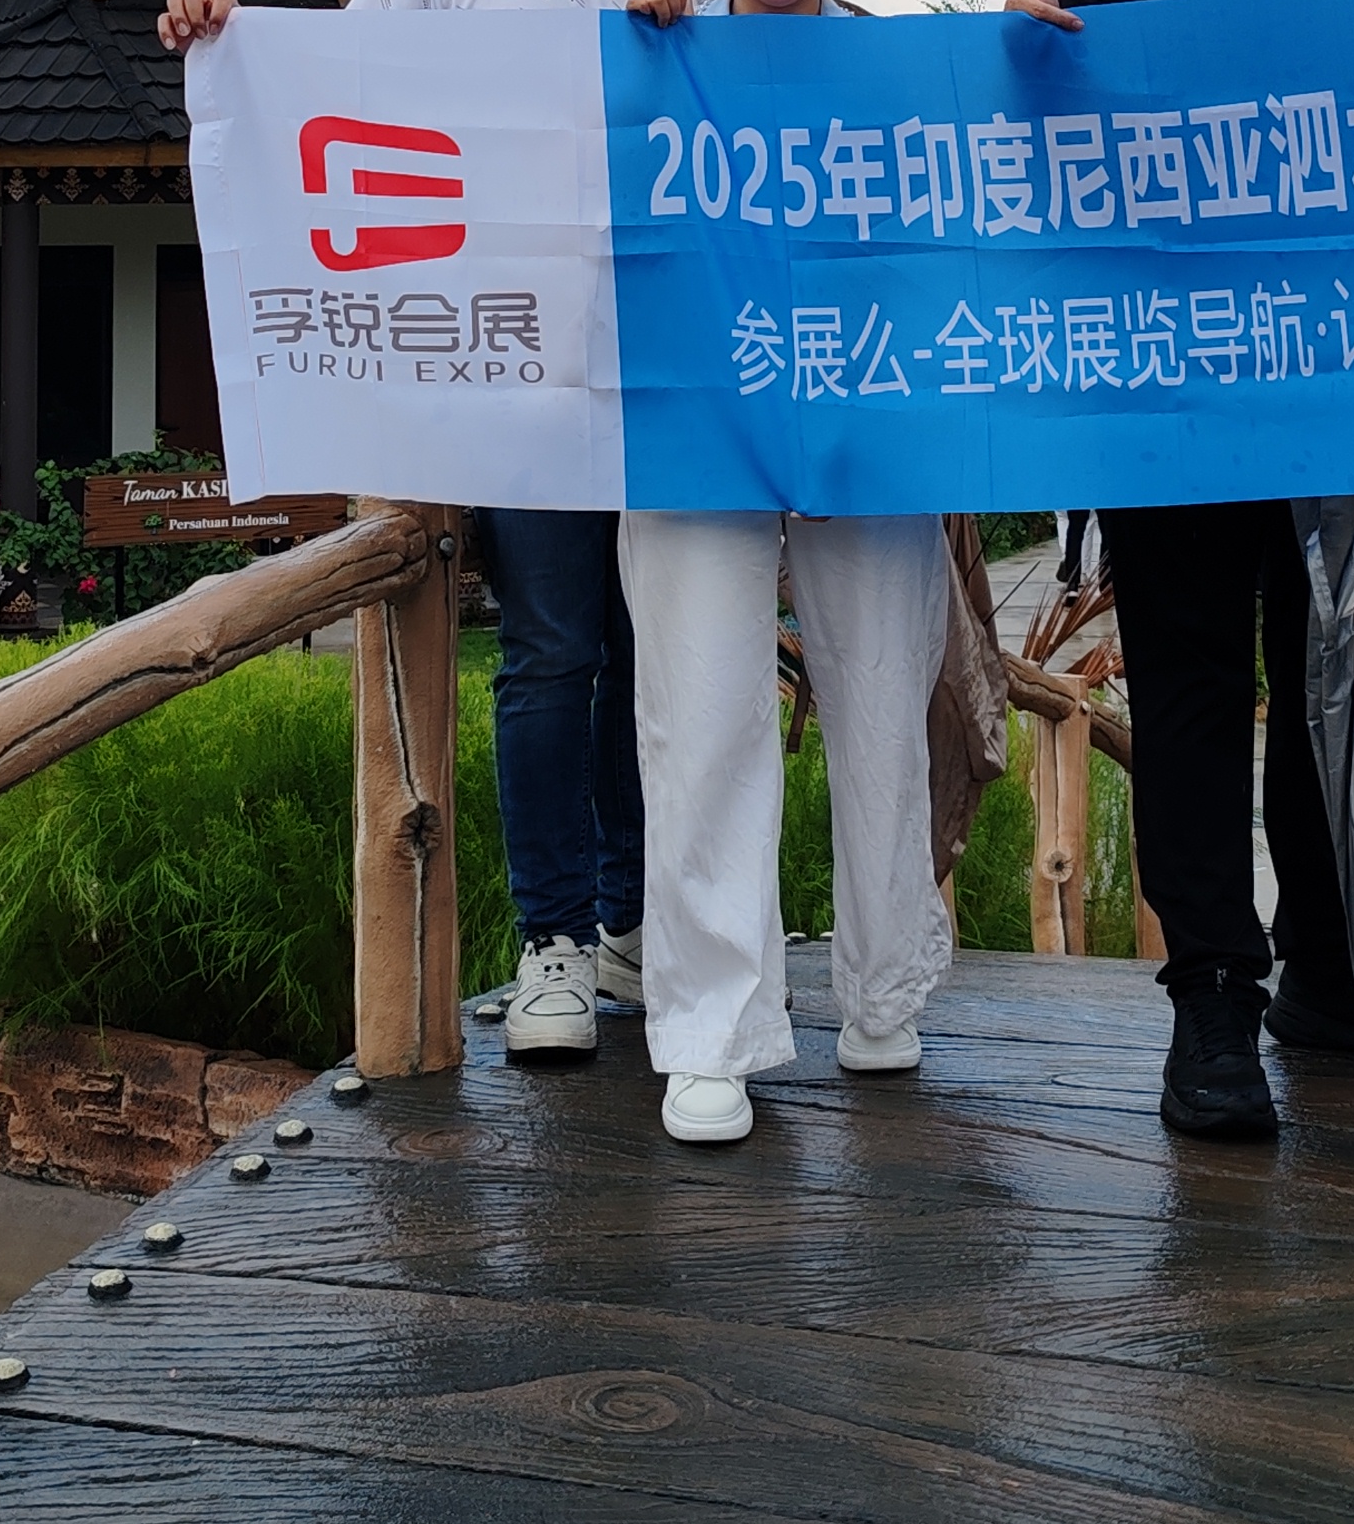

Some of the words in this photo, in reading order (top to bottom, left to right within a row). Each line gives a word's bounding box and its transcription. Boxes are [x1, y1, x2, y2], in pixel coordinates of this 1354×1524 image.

[248, 287, 543, 353] 孚锐会展
[256, 352, 384, 381] FURUI
[415, 360, 545, 384] EXPO
[123, 480, 179, 507] Taman
[168, 517, 229, 531] Persatuan
[231, 512, 290, 527] Indonesia
